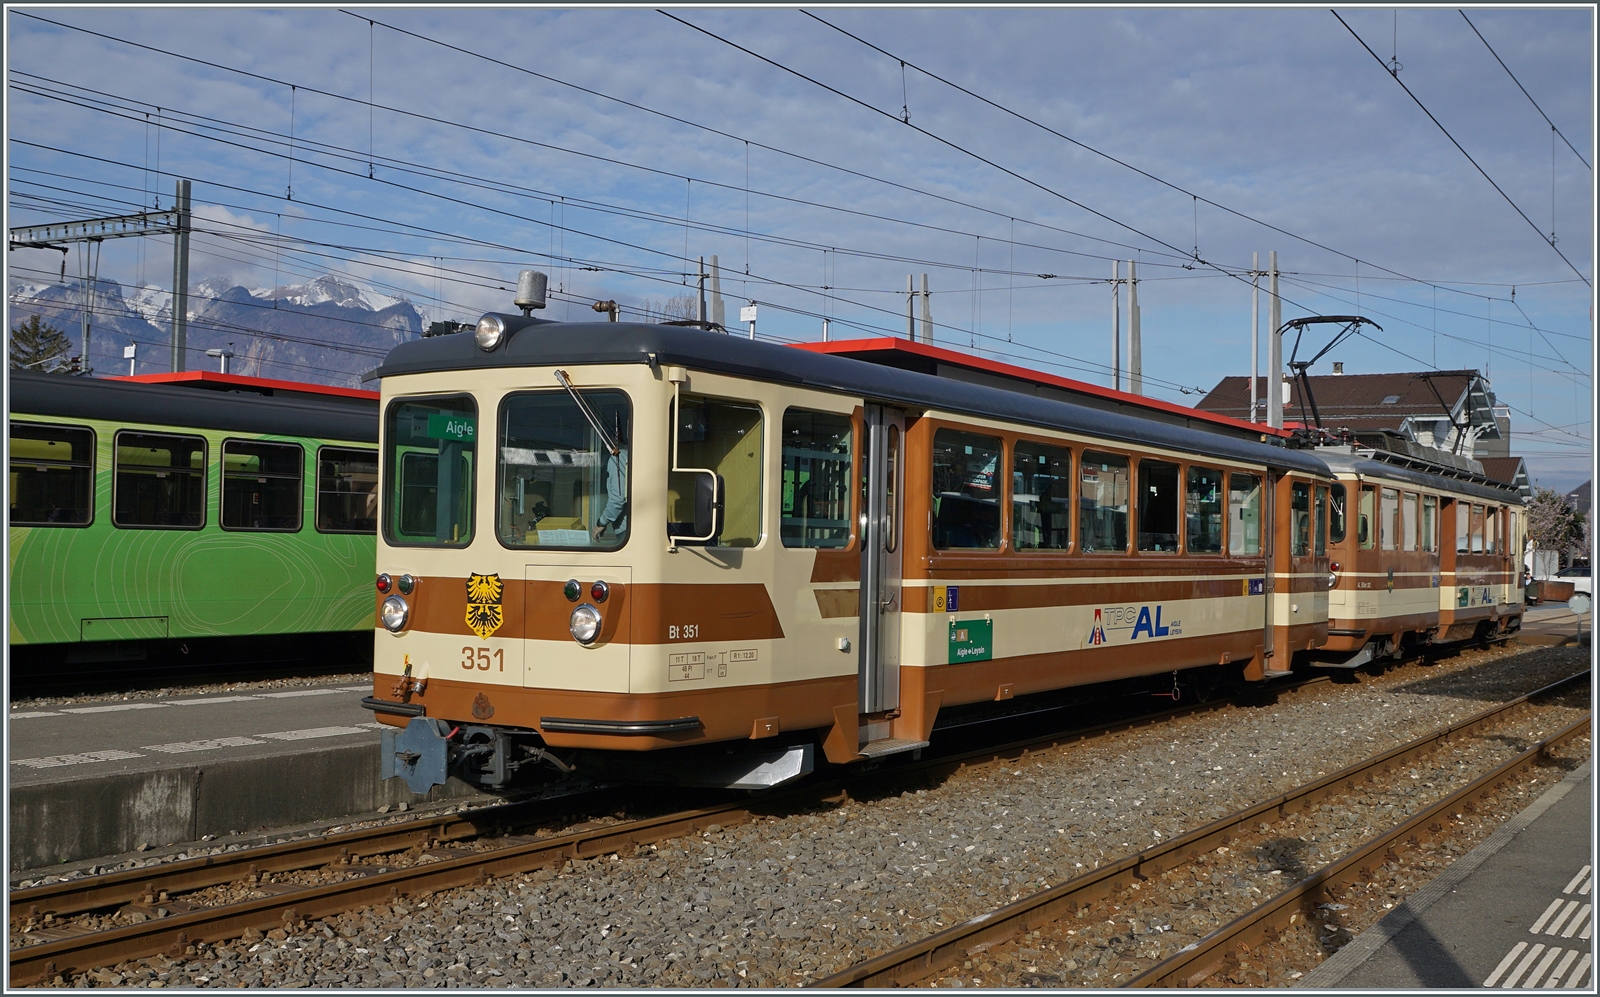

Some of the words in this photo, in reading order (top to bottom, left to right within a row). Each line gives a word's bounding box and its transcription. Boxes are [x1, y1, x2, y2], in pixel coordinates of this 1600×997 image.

[446, 420, 474, 438] Aigle
[1104, 606, 1137, 626] TPC
[1131, 605, 1169, 640] AL
[669, 625, 680, 639] Bt
[683, 624, 699, 639] 351
[960, 631, 965, 640] A
[461, 646, 504, 672] 351
[956, 648, 968, 658] Aigle
